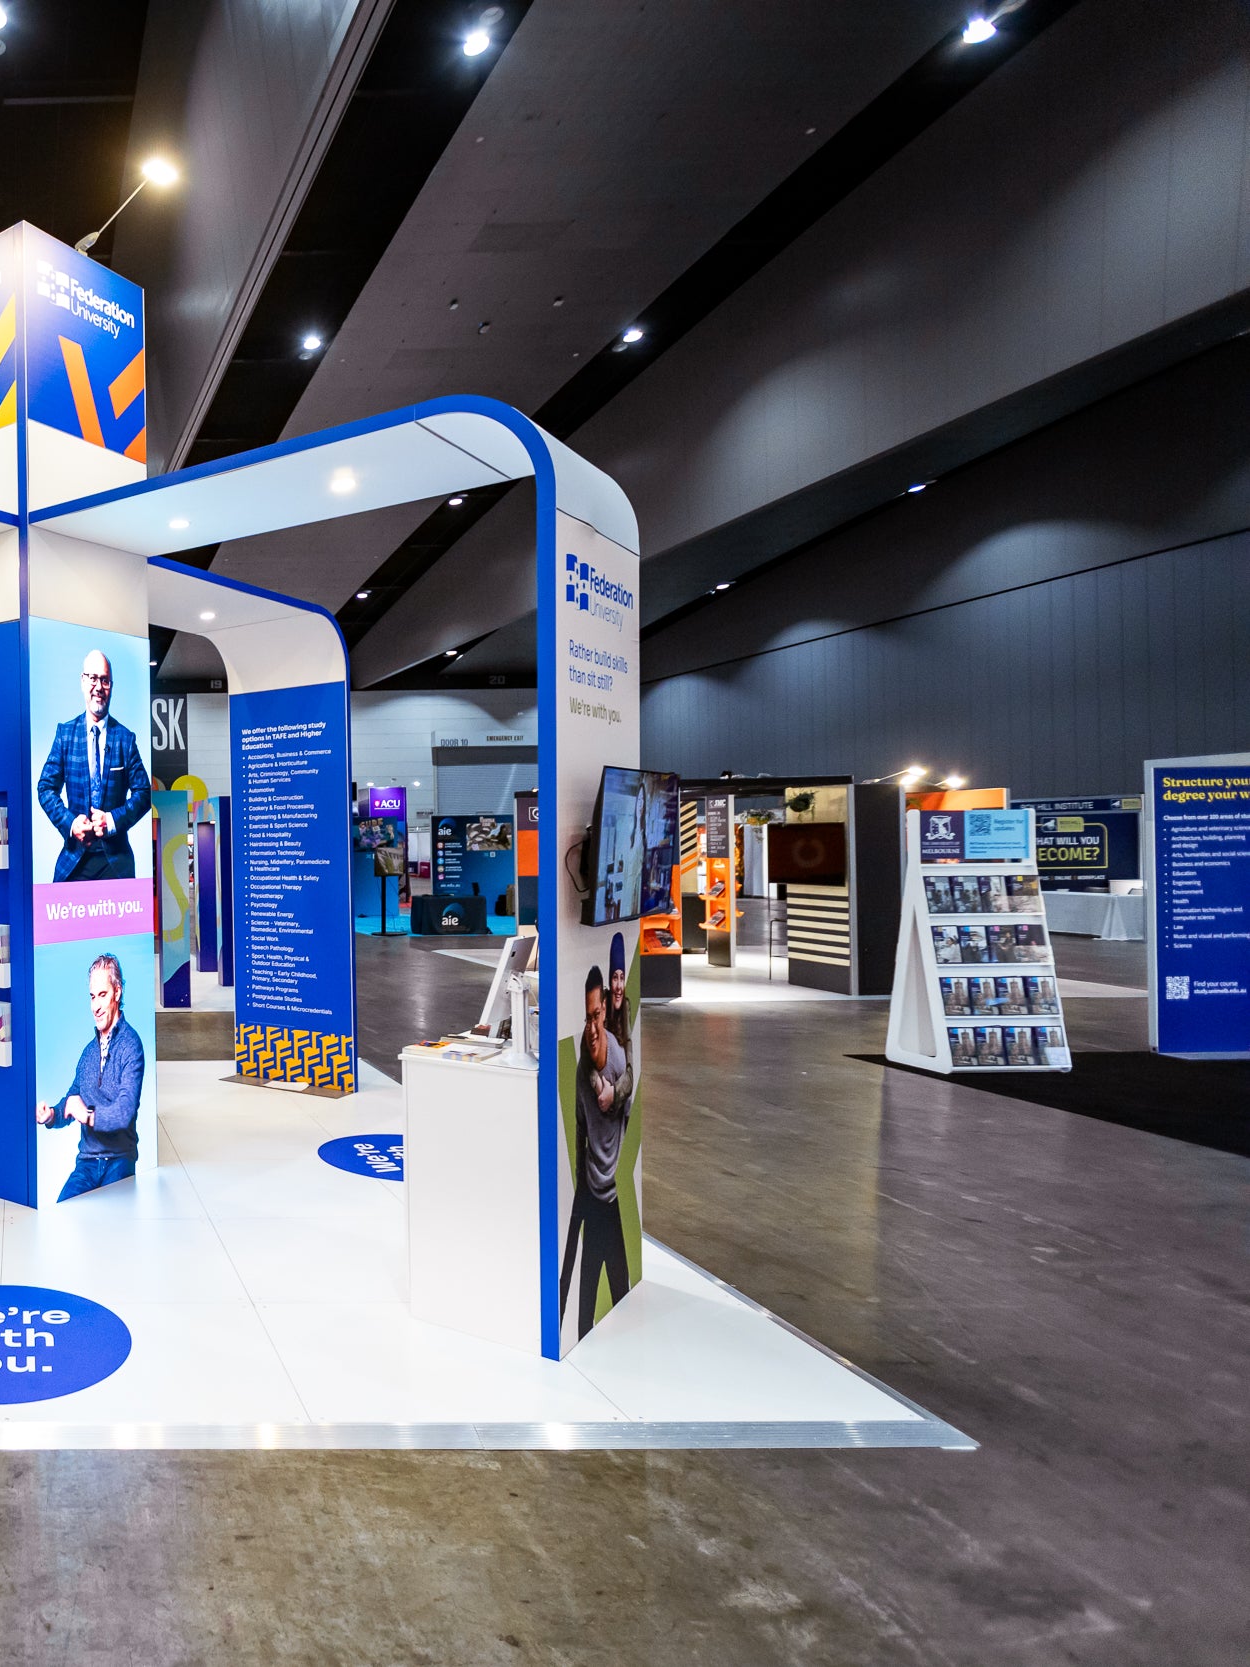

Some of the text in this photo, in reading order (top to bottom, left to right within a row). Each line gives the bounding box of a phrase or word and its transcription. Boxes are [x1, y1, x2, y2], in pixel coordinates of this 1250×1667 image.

[70, 278, 135, 329] Federation
[70, 300, 121, 340] University
[589, 567, 634, 610] Federation
[589, 598, 624, 633] University
[569, 639, 628, 674] Rather build skills
[569, 665, 613, 692] than sit still?
[569, 696, 622, 725] We're with you.
[241, 728, 251, 736] We
[251, 727, 266, 735] offer
[278, 723, 307, 732] following
[308, 721, 326, 730] study
[241, 735, 265, 744] options
[287, 731, 300, 739] and
[301, 730, 322, 738] Higher
[440, 738, 458, 747] DOOR
[241, 743, 274, 751] Education:
[1163, 777, 1223, 788] Structure
[1163, 789, 1237, 803] degree your
[381, 799, 400, 808] ACU
[1055, 801, 1094, 809] INSTITUTE
[437, 827, 452, 836] aie
[1036, 836, 1100, 845] HAT WILL YOU
[277, 849, 305, 857] Technology
[1038, 847, 1100, 861] ECOME?
[46, 899, 144, 921] We're with you.
[441, 915, 459, 926] aie
[266, 1003, 286, 1011] Courses
[291, 1005, 332, 1015] Microcredentials
[353, 1143, 402, 1173] We're
